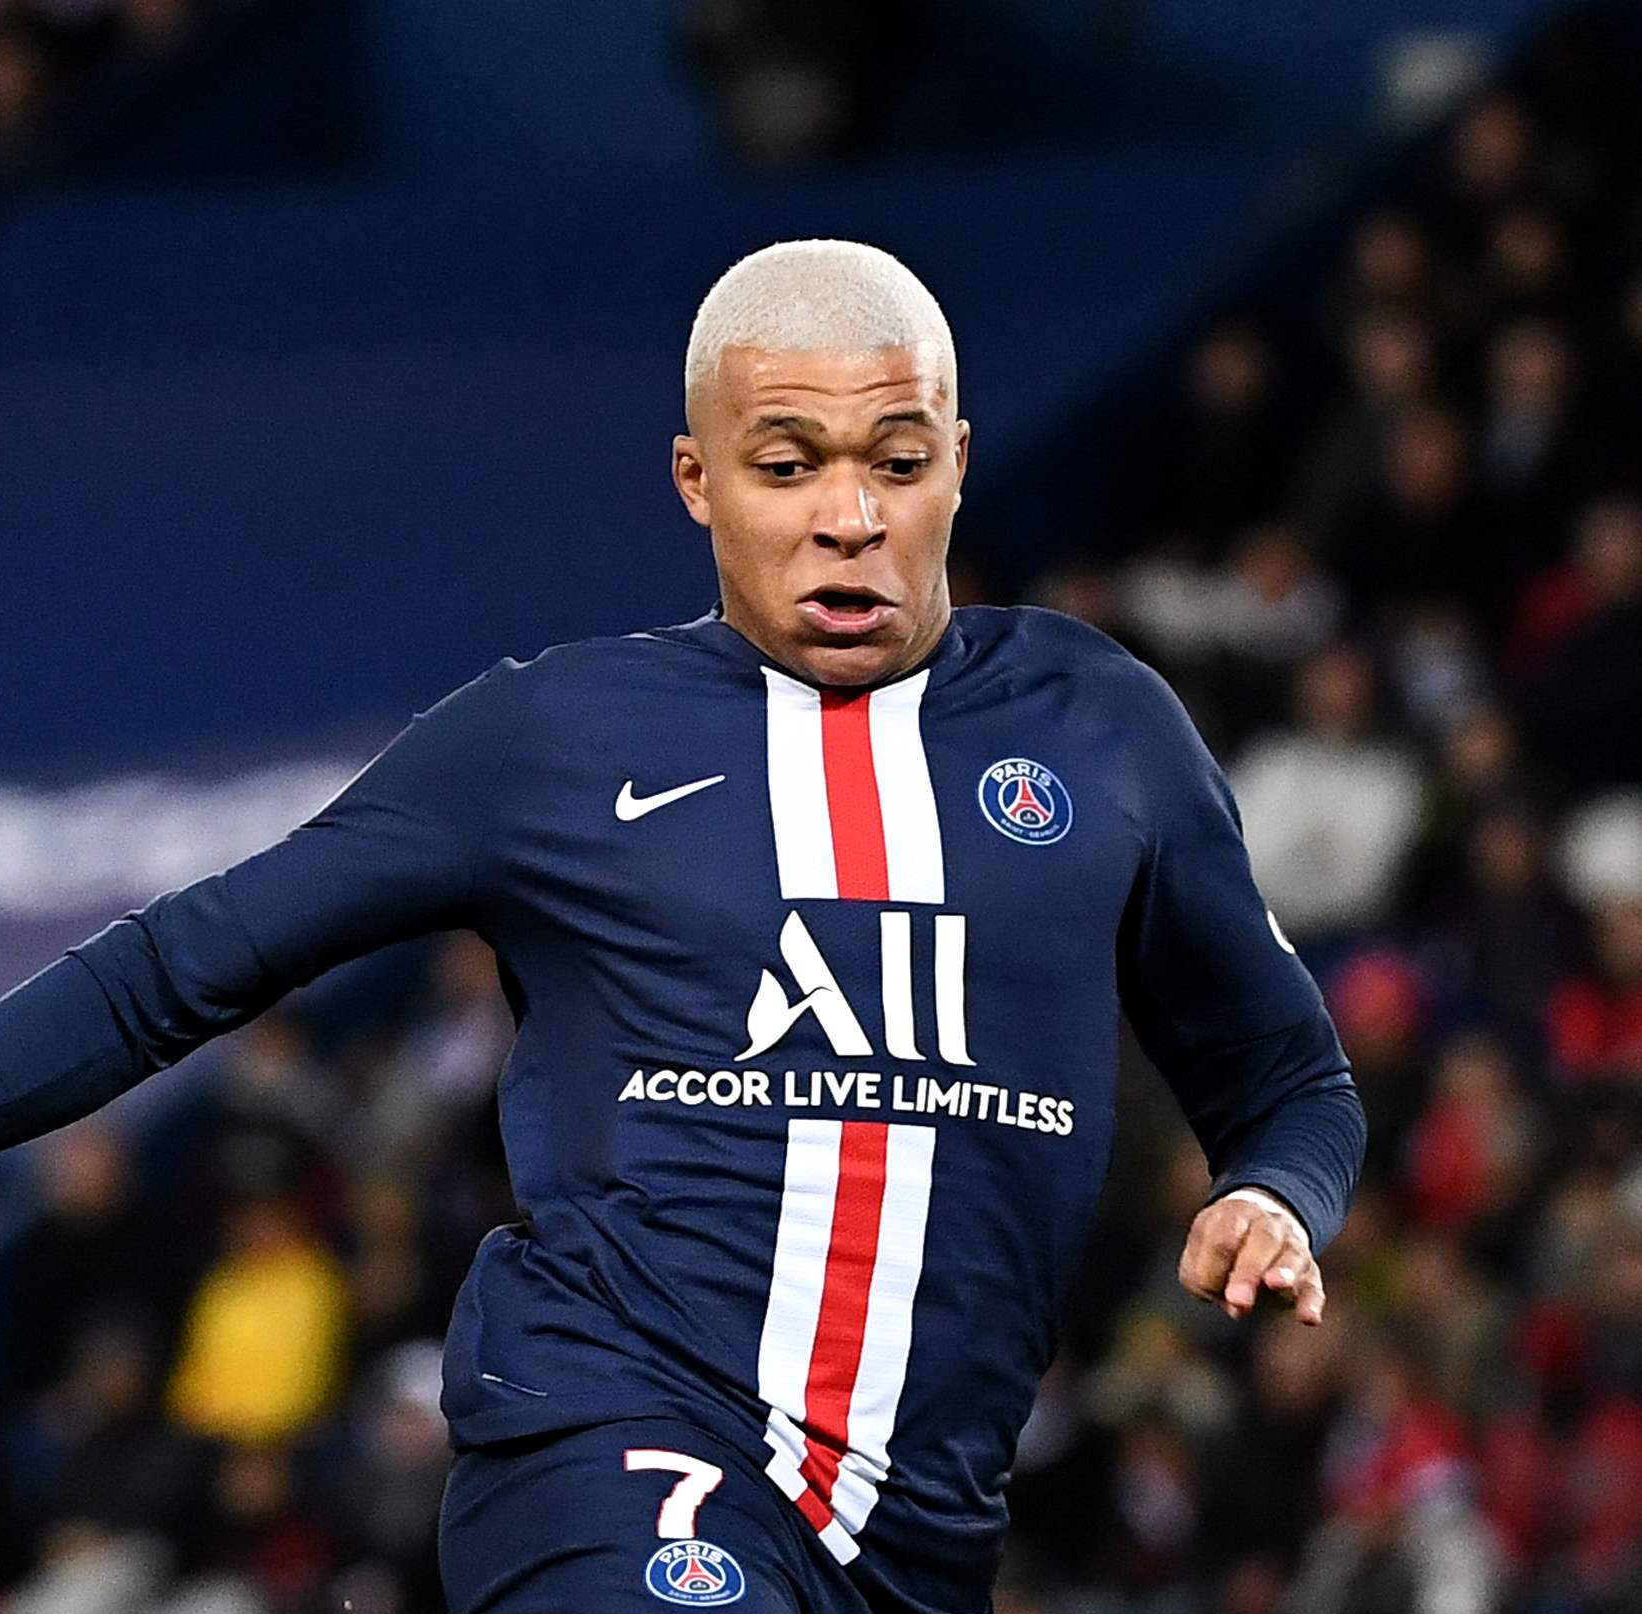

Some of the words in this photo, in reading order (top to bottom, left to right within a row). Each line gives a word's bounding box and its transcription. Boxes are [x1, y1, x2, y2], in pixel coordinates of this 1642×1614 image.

[991, 762, 1052, 787] PARIS
[617, 1069, 772, 1106] ACCOR
[784, 1070, 882, 1108] LIVE
[892, 1075, 1074, 1136] LIMITLESS
[623, 1449, 724, 1539] 7
[658, 1544, 724, 1564] PARIS
